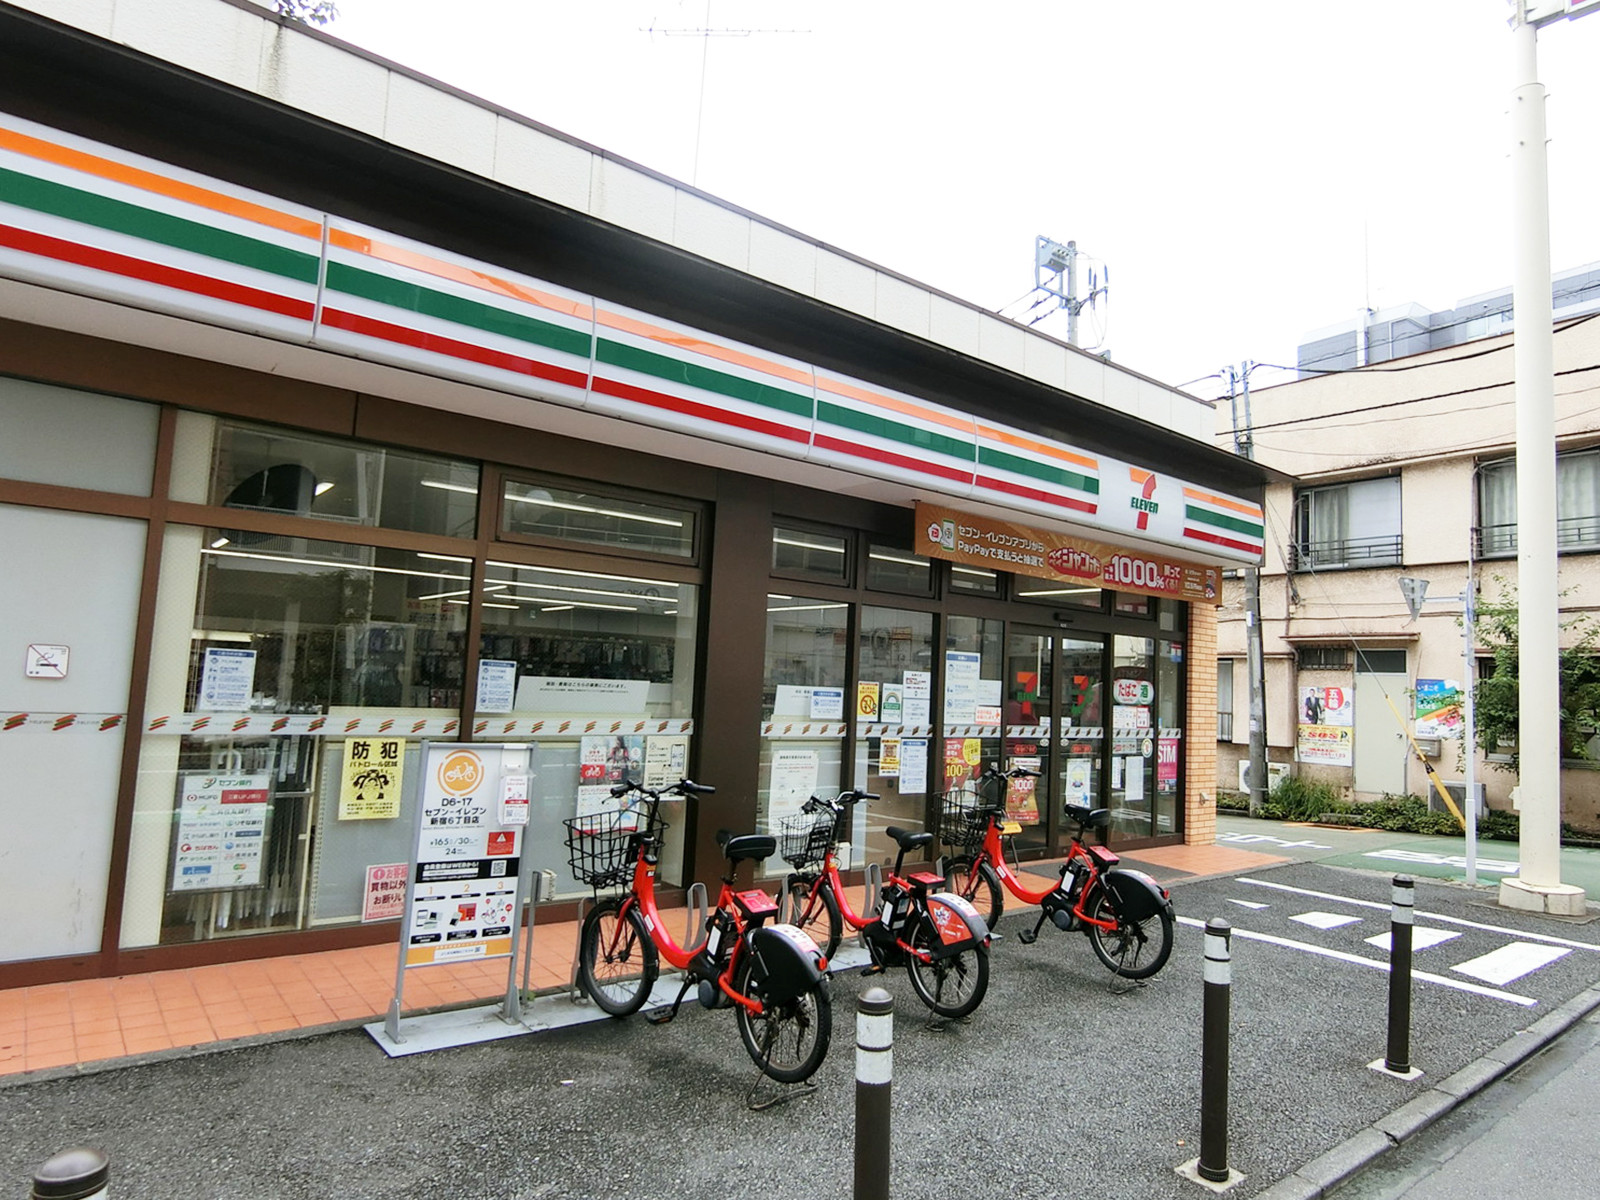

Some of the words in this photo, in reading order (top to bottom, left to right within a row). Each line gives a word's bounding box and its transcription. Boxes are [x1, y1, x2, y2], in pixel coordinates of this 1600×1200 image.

[1117, 683, 1137, 697] たばこ
[352, 741, 398, 759] 防犯
[1157, 744, 1177, 764] SIM
[441, 797, 473, 807] D6-17
[430, 816, 480, 825] 新宿6丁目店
[464, 884, 470, 892] 2
